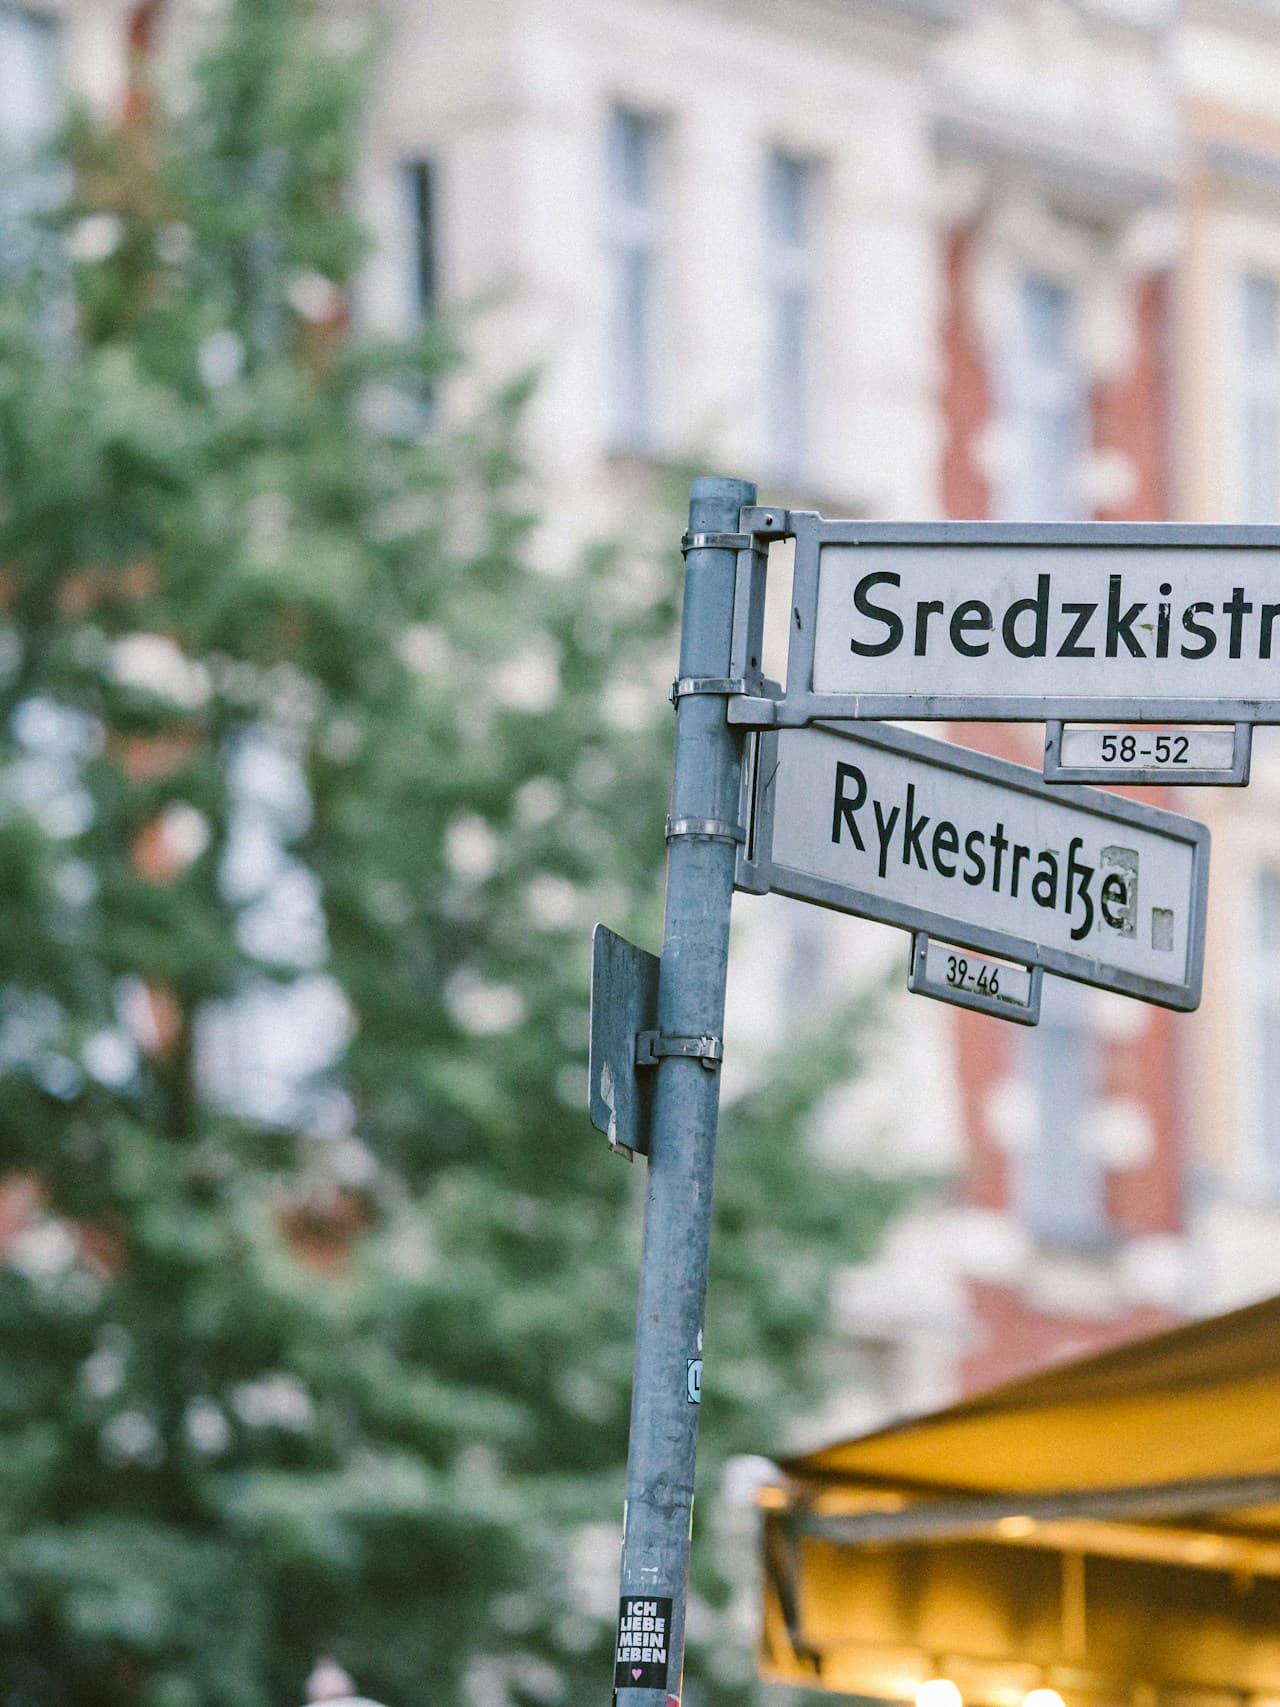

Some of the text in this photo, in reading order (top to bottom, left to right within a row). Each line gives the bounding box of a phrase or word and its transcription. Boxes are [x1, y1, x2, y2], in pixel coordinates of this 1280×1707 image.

[1101, 735, 1189, 764] 58-52
[832, 761, 1128, 941] Rykestraße
[946, 956, 999, 995] 39-46
[627, 1601, 657, 1617] ICH
[620, 1616, 665, 1632] LIEBE
[619, 1632, 664, 1648] MEIN
[617, 1647, 667, 1664] LEBEN
